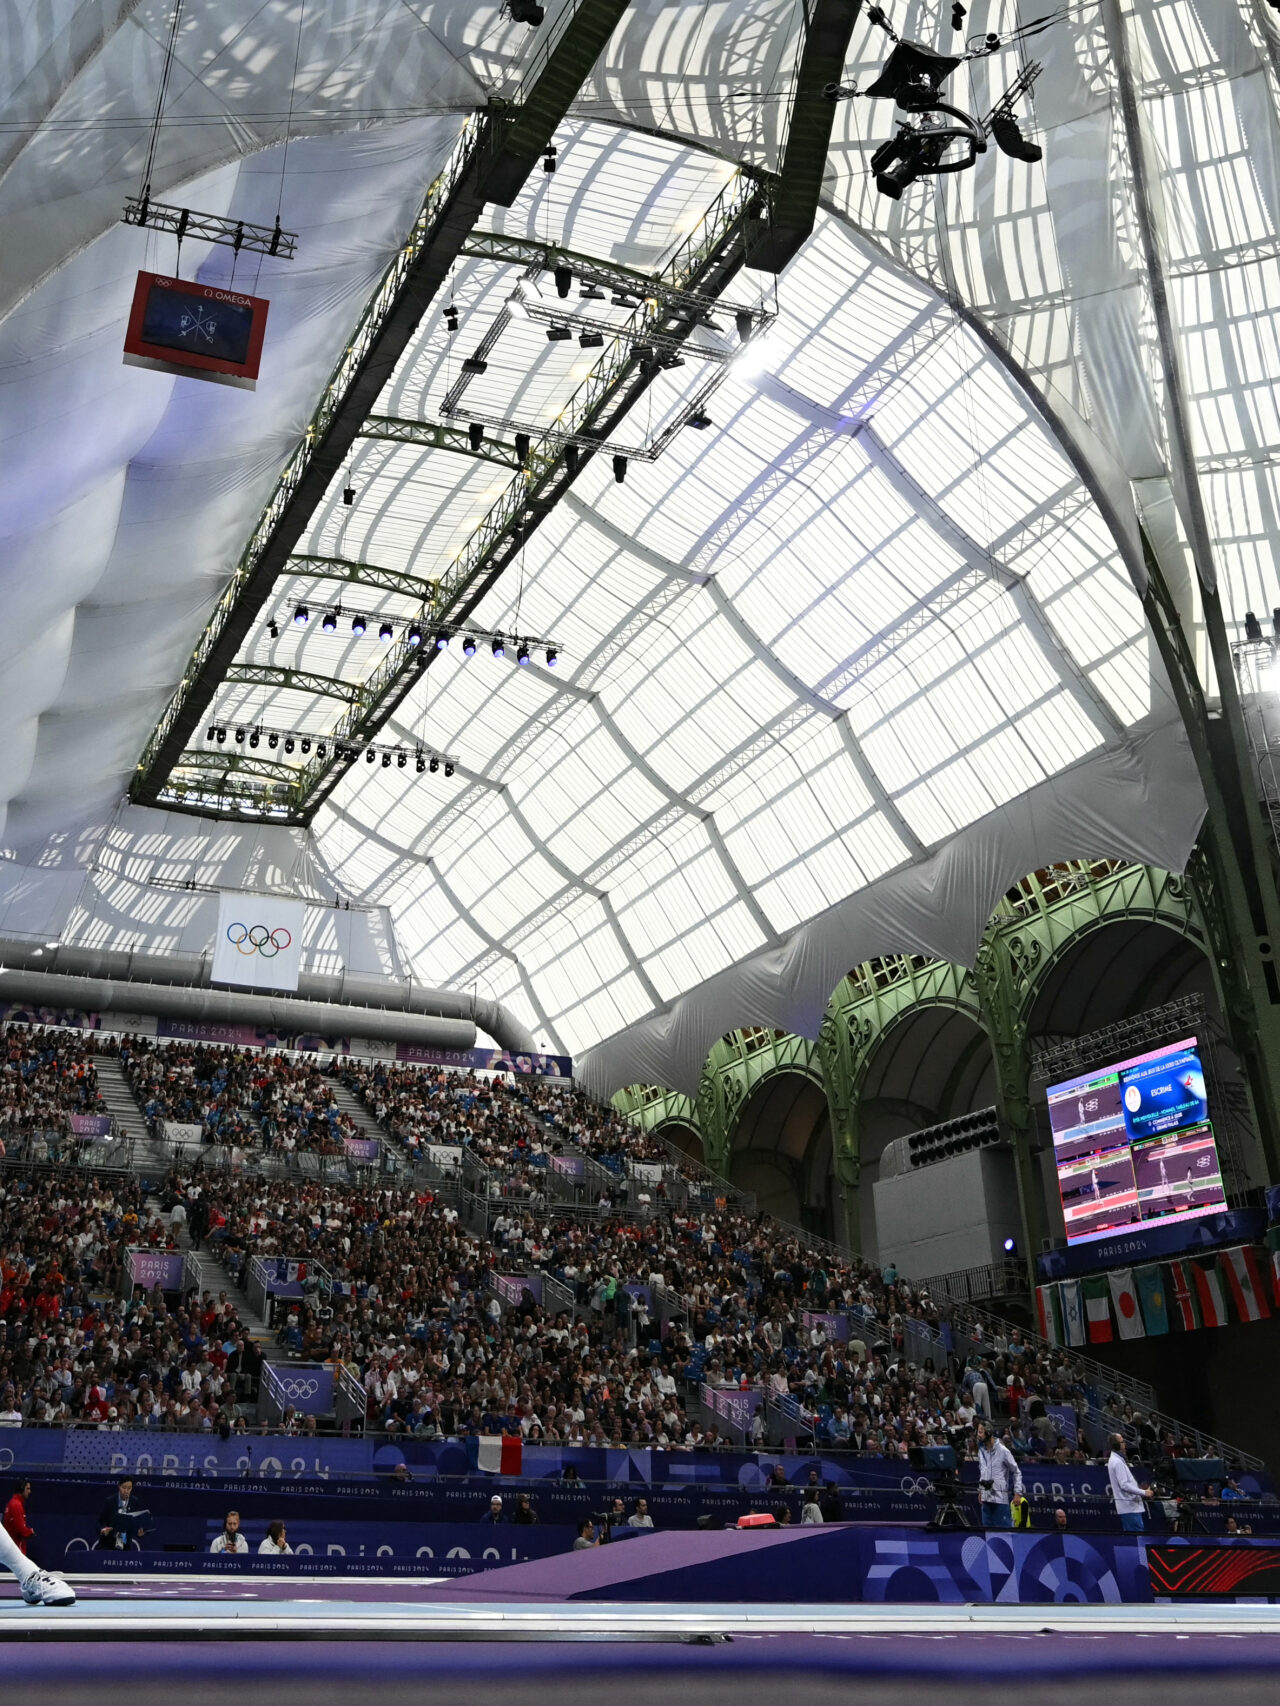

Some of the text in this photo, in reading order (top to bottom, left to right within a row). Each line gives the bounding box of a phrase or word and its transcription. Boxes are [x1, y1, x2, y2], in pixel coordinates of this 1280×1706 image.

[215, 291, 251, 306] OMEGA
[171, 1023, 241, 1038] PARIS 2024
[409, 1047, 475, 1063] PARIS 2024
[1150, 1084, 1173, 1097] ESCRIME
[141, 1260, 169, 1270] PARIS
[140, 1270, 169, 1280] 2024
[190, 1482, 210, 1490] 2024
[304, 1486, 324, 1494] 2024
[337, 1487, 380, 1496] PARIS 2024
[392, 1489, 434, 1498] PARIS 2024
[469, 1491, 487, 1499] 2024
[674, 1497, 691, 1505] 2024
[771, 1500, 787, 1508] 2024
[125, 1560, 143, 1568] 2024
[174, 1561, 193, 1569] 2024
[223, 1562, 242, 1570] 2024
[272, 1563, 290, 1571] 2024
